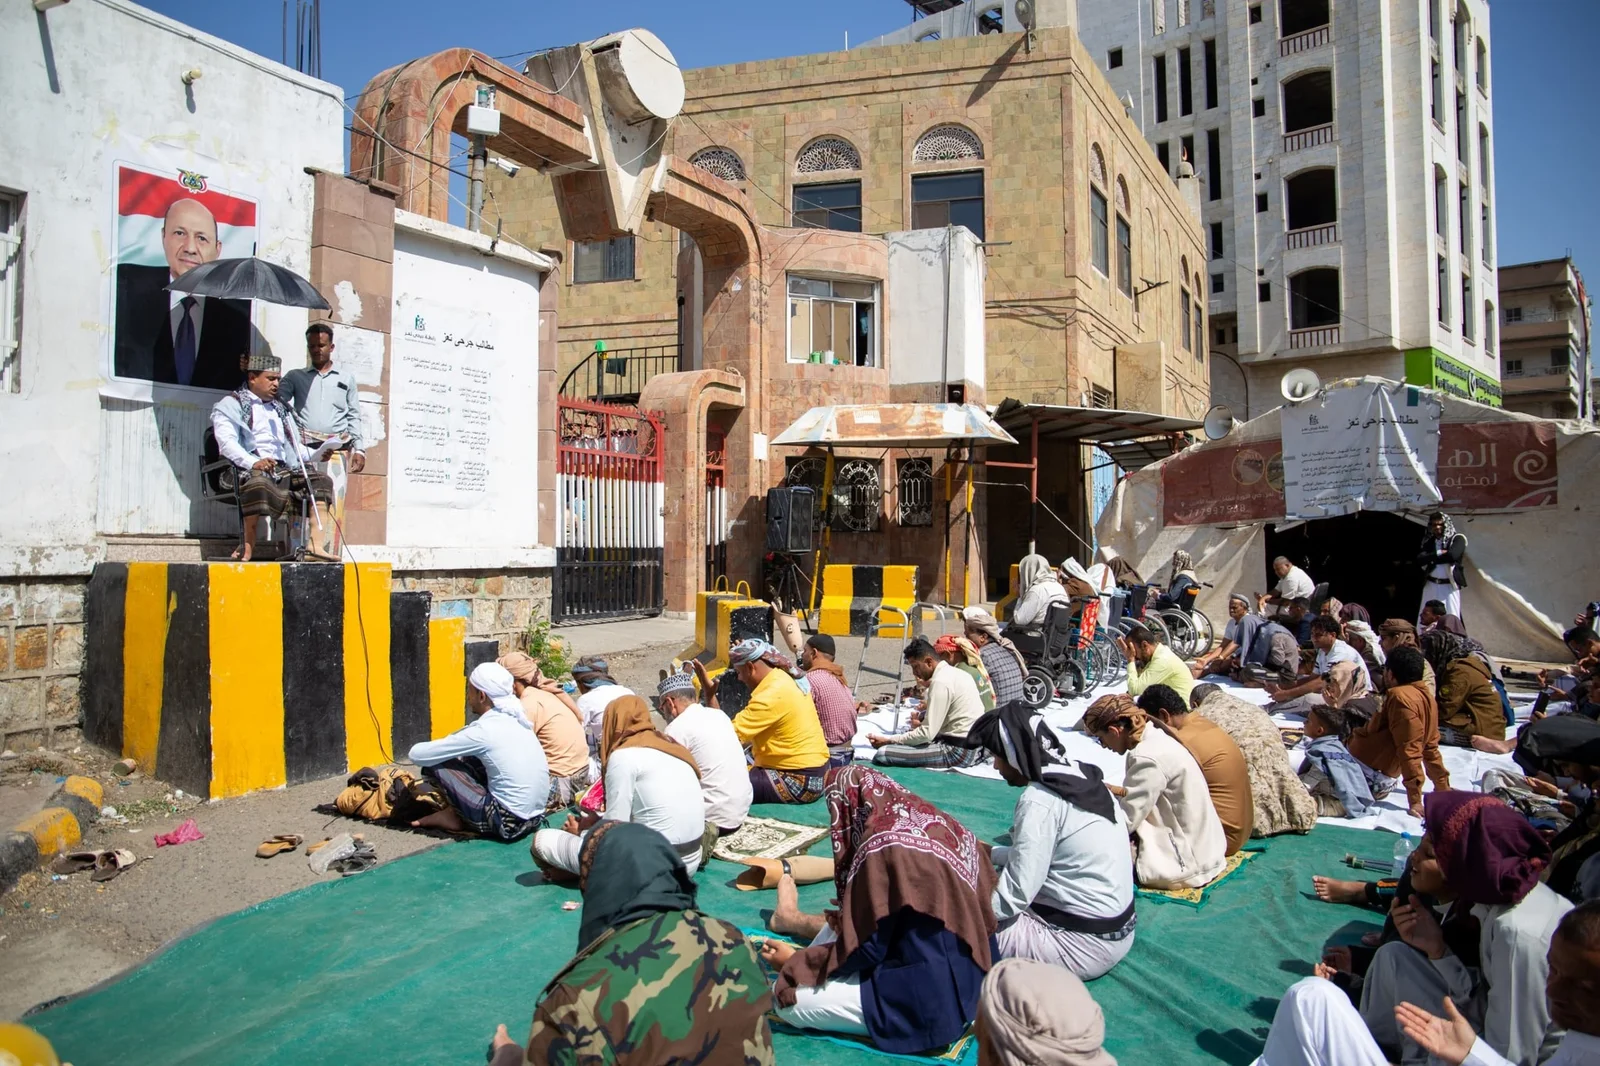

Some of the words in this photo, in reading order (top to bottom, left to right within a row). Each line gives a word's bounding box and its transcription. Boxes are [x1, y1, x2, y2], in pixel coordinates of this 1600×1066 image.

[442, 332, 453, 343] تعز
[454, 338, 474, 348] جرحى
[475, 339, 494, 350] مطالب
[1346, 416, 1359, 430] تعز
[1362, 416, 1387, 429] جرحى
[1390, 415, 1419, 426] مطالب
